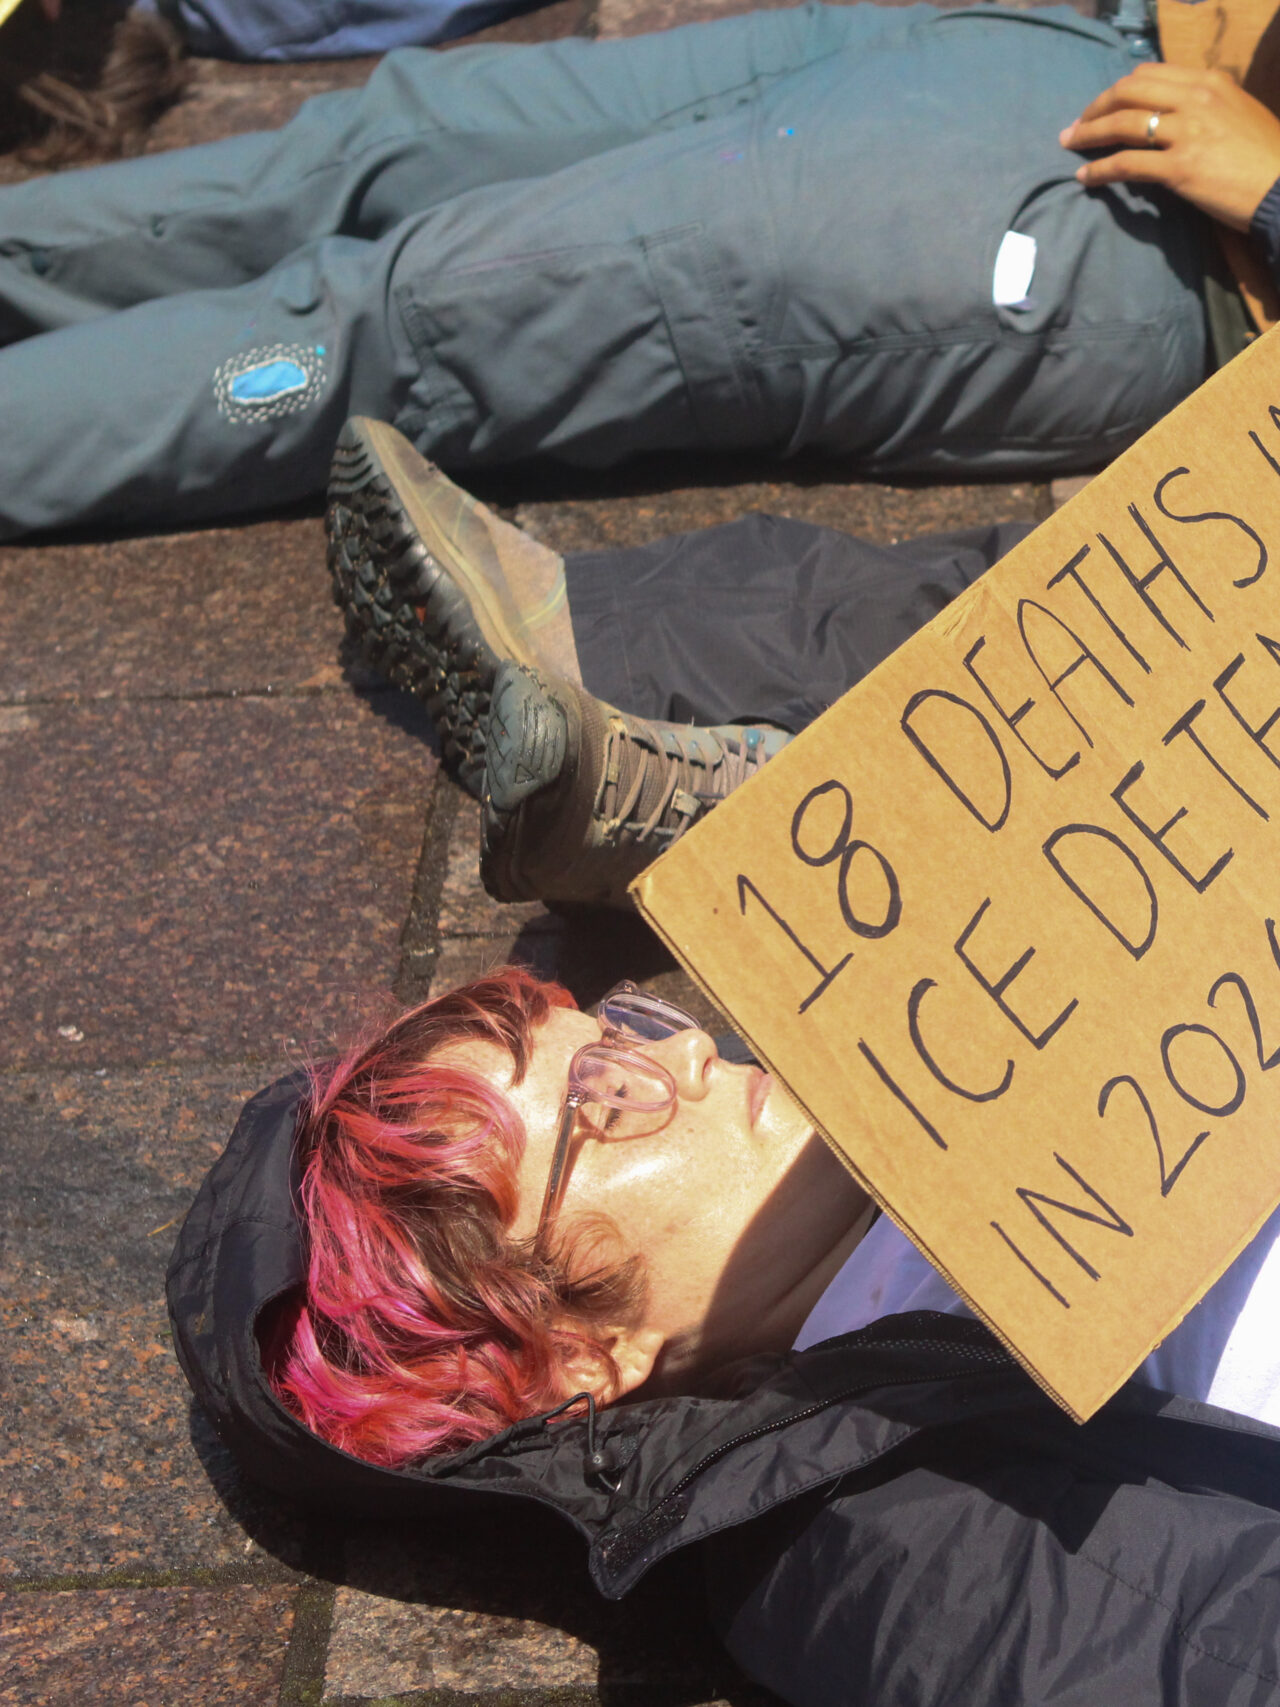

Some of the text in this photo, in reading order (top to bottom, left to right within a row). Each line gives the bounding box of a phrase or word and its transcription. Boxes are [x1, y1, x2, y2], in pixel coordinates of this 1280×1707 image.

[737, 779, 903, 1015] 18
[899, 466, 1268, 834] DEATHS
[857, 897, 1079, 1151] ICE
[990, 1152, 1134, 1309] IN
